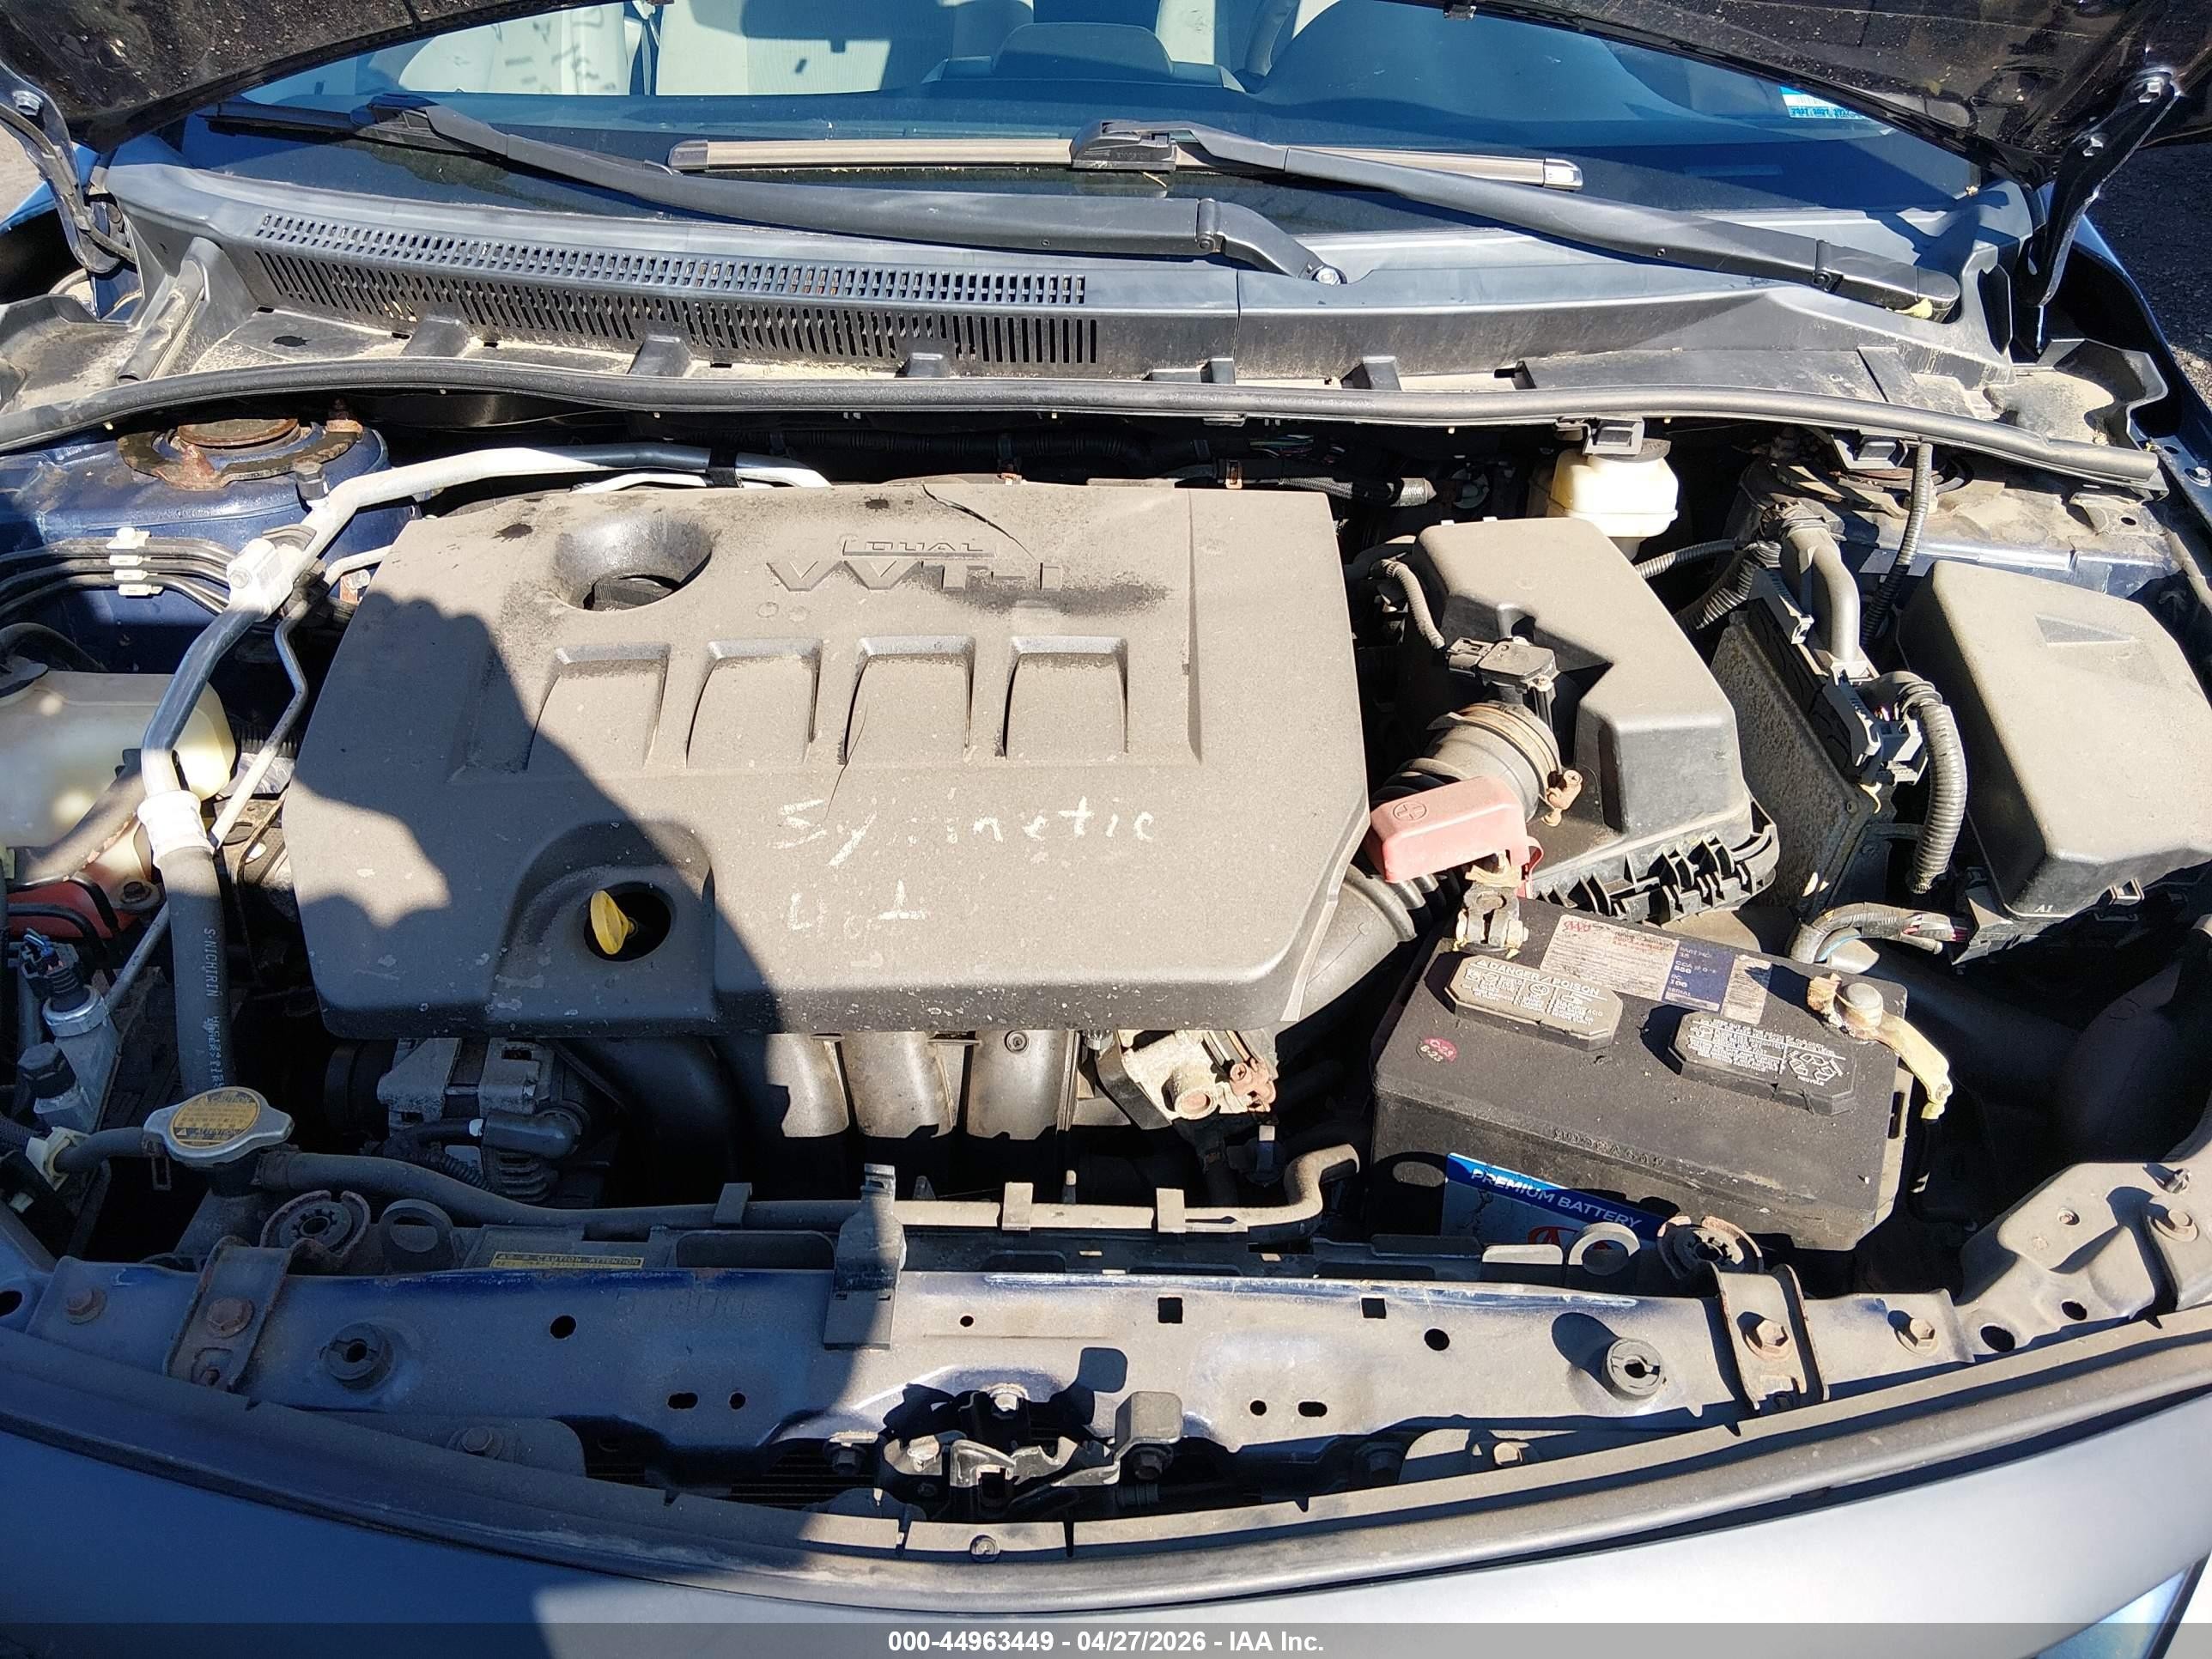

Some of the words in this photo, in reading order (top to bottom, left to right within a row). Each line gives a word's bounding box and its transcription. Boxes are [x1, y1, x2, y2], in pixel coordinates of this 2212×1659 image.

[864, 540, 984, 552] DUAL
[1471, 1167, 1556, 1203] PREMIUM
[1557, 1195, 1643, 1229] BATTERY
